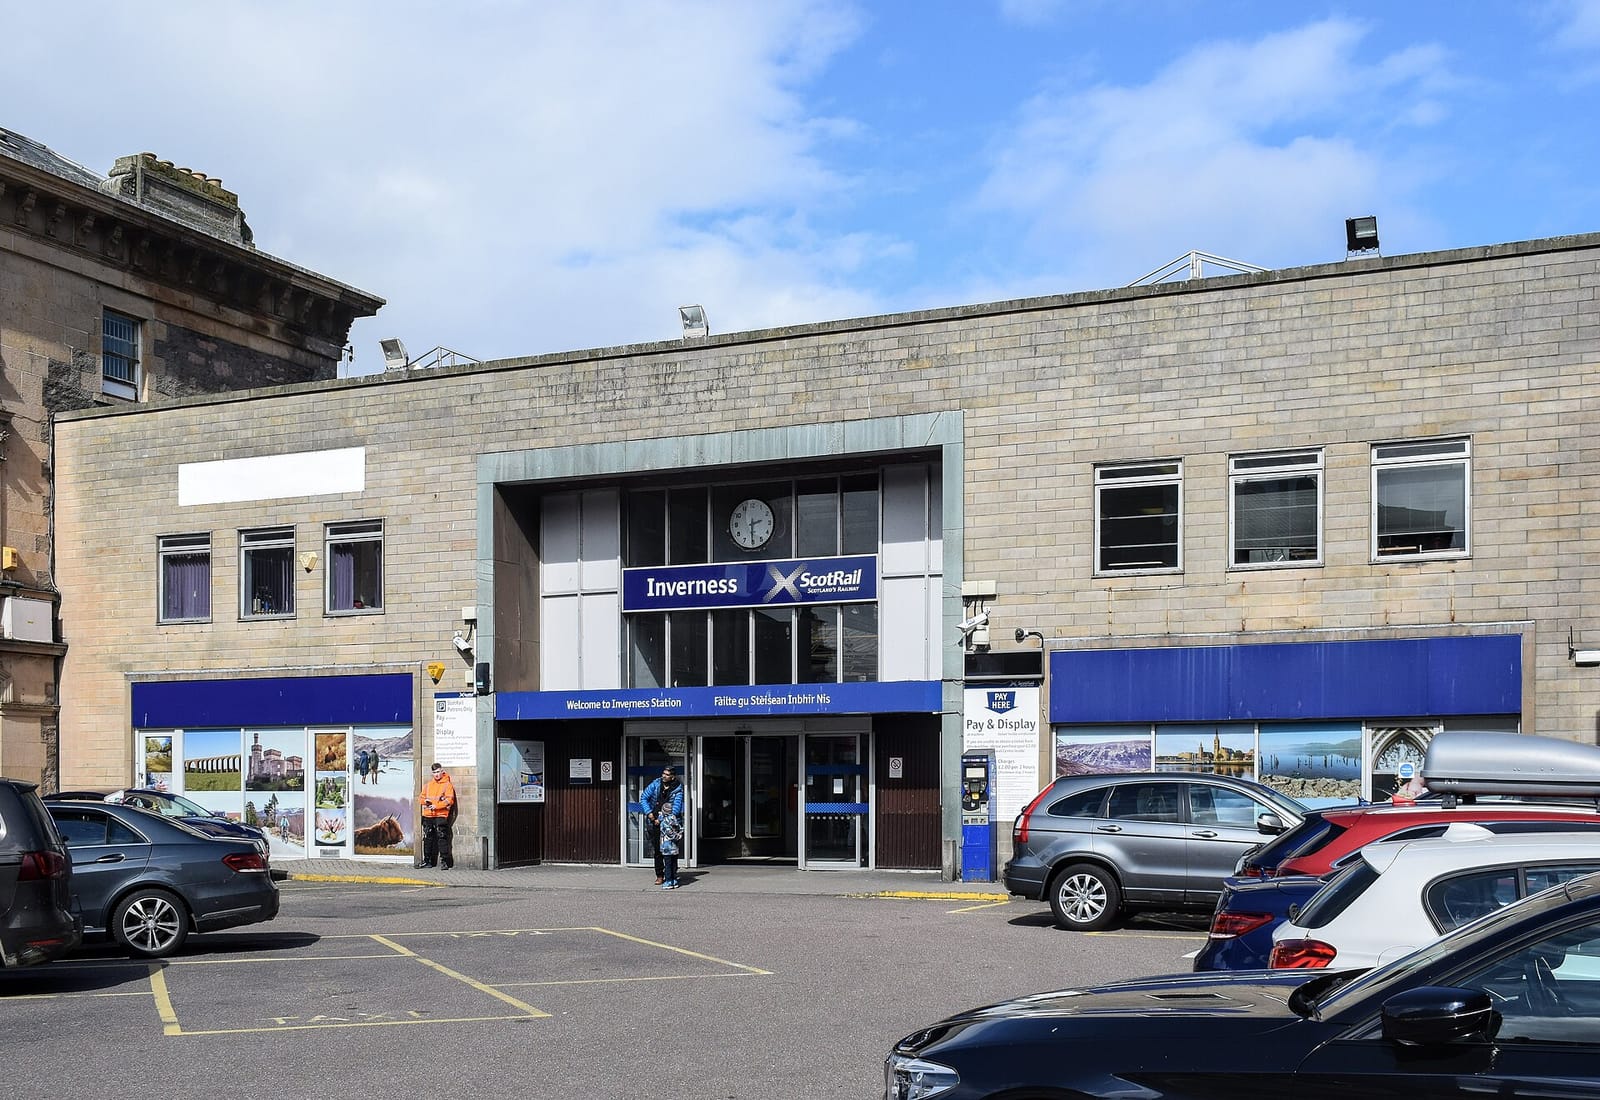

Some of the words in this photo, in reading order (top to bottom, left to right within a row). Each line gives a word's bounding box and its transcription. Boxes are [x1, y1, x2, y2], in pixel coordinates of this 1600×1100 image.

[799, 568, 862, 588] ScotRail
[647, 577, 738, 597] Inverness
[566, 699, 601, 710] Welcome
[602, 699, 611, 709] to
[611, 698, 650, 709] Inverness
[651, 697, 682, 708] Station
[714, 695, 737, 706] Fàilte
[738, 697, 749, 708] gu
[750, 694, 786, 706] Stèisean
[788, 693, 815, 705] Inbhir
[816, 693, 831, 704] Nis
[994, 692, 1008, 701] PAY
[992, 701, 1011, 709] HERE
[436, 728, 454, 736] Display
[966, 719, 984, 733] Pay
[986, 718, 995, 730] &
[998, 718, 1036, 732] Display
